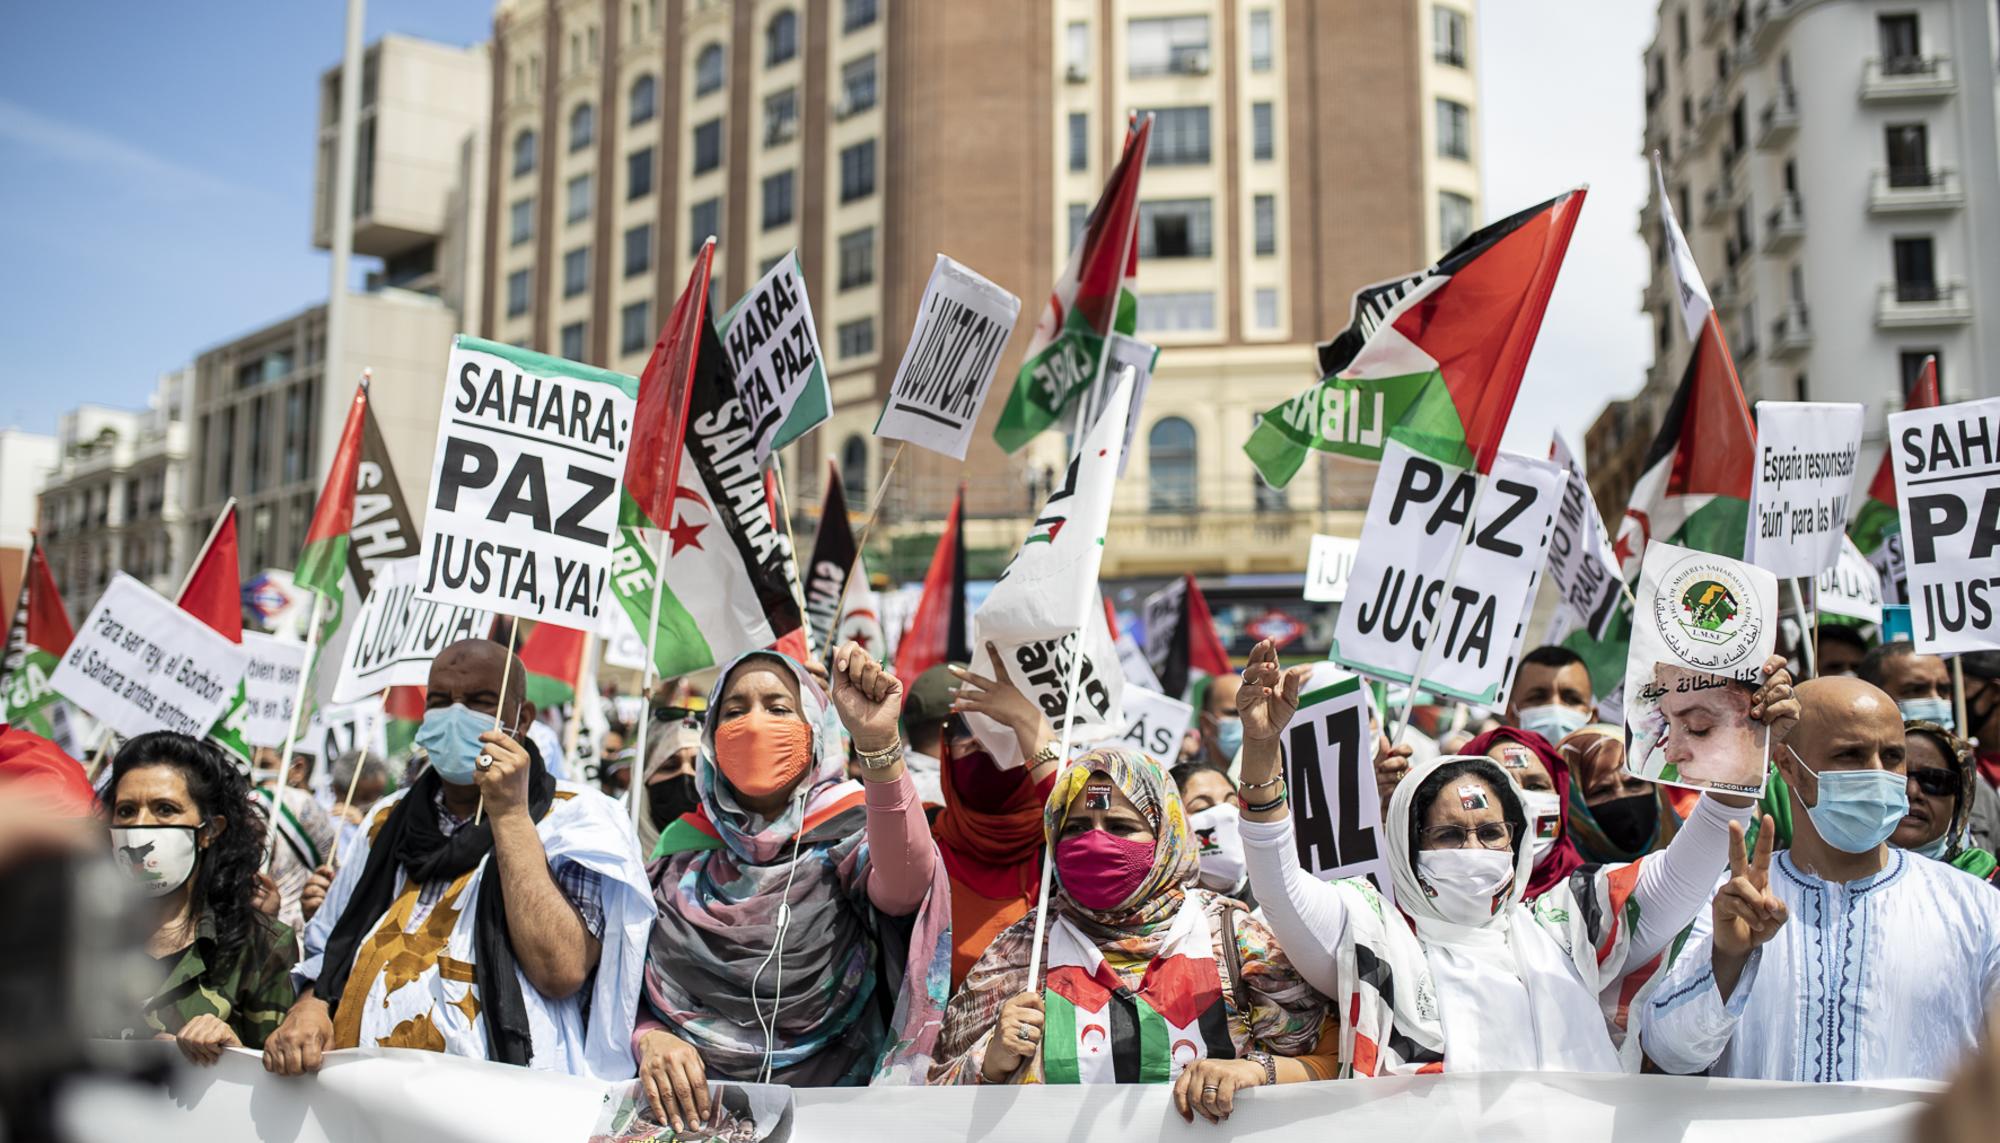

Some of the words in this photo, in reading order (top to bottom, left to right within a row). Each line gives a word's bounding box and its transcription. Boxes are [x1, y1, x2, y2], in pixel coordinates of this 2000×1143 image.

[725, 272, 798, 380] HARA:
[770, 315, 817, 394] PAZ!
[897, 292, 1008, 420] ¡JUSTICIA!
[455, 362, 628, 452] SAHARA:
[1902, 416, 2000, 475] SAH
[435, 436, 617, 548] PAZ
[1389, 456, 1538, 557] PAZ
[1763, 446, 1802, 491] España
[1758, 501, 1789, 538] "aún"
[1791, 507, 1813, 545] para
[1817, 498, 1828, 532] las
[92, 608, 123, 643] Para
[124, 628, 144, 655] ser
[163, 654, 183, 676] el
[177, 657, 223, 703] Borbón
[1357, 565, 1497, 668] JUSTA
[68, 645, 88, 668] el
[81, 649, 124, 693] Sahara
[123, 678, 157, 713] antes
[1676, 674, 1729, 694] سلطانة
[1734, 667, 1760, 684] كلنا
[1123, 712, 1173, 755] ÁS
[1280, 705, 1378, 874] AZ
